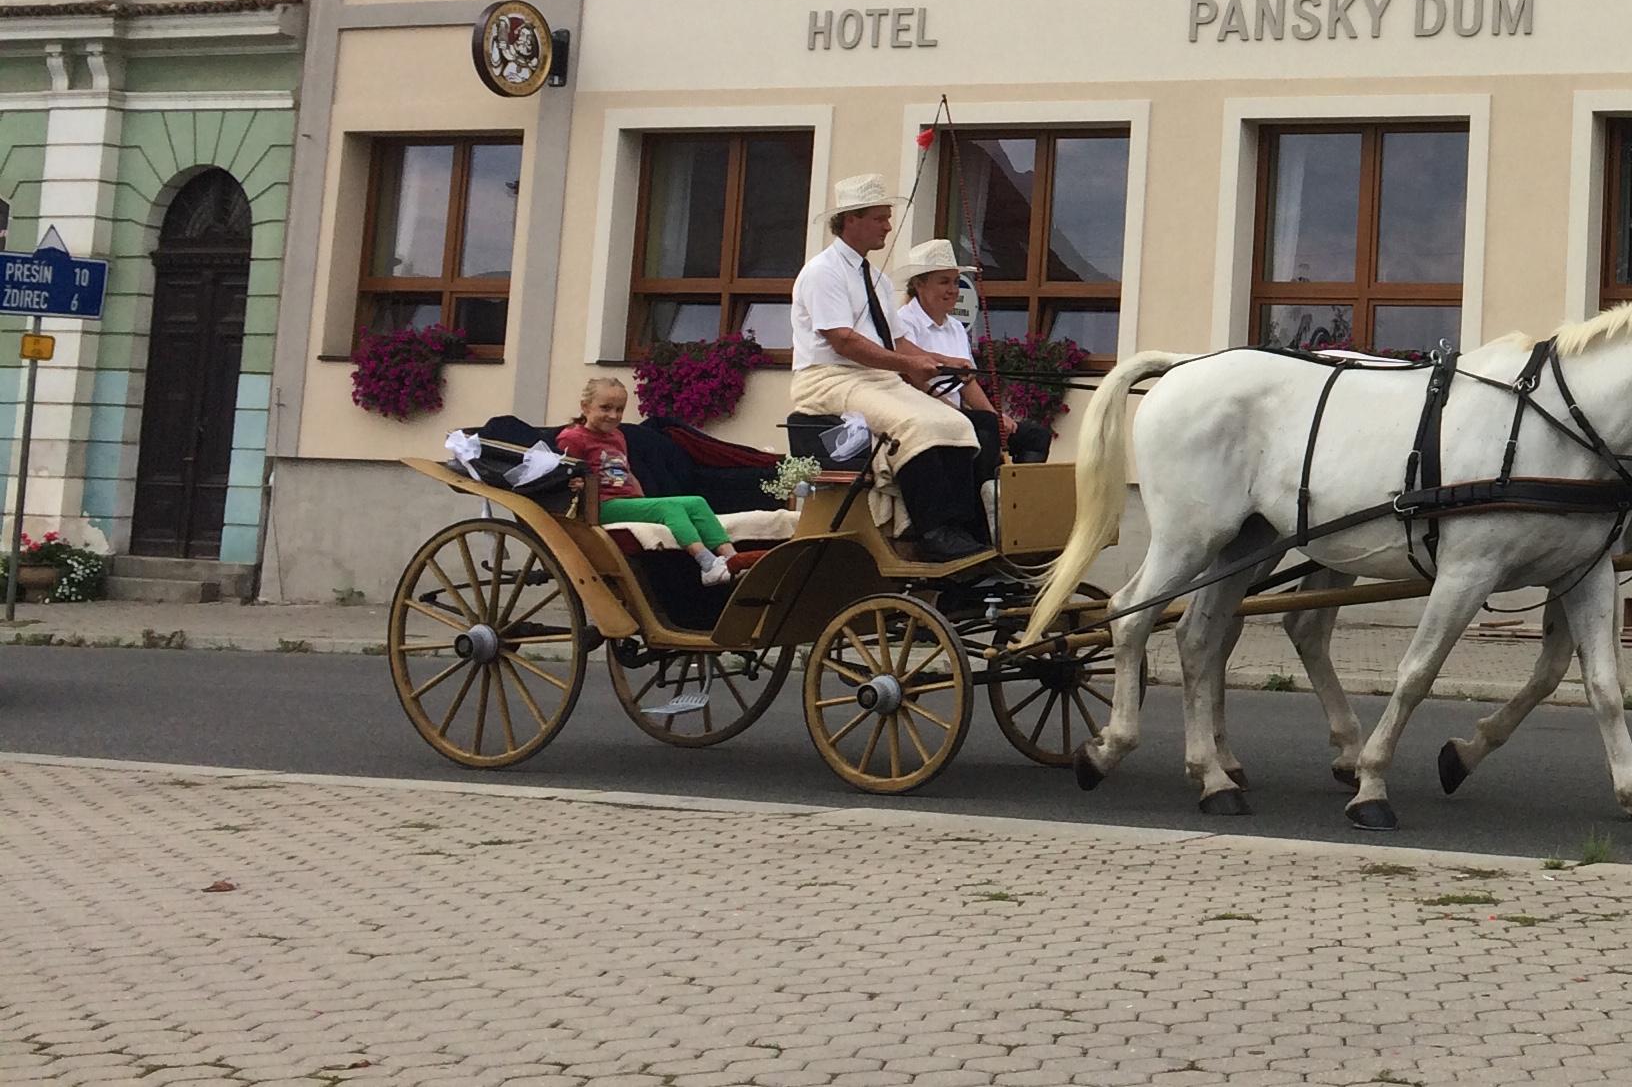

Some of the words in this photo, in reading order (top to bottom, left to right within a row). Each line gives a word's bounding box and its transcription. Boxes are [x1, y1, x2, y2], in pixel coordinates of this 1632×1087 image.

[807, 7, 939, 51] HOTEL
[5, 258, 53, 284] PŘEŠÍN
[74, 267, 90, 287] 10
[2, 284, 49, 309] ŽDÍREC
[70, 293, 79, 311] 6
